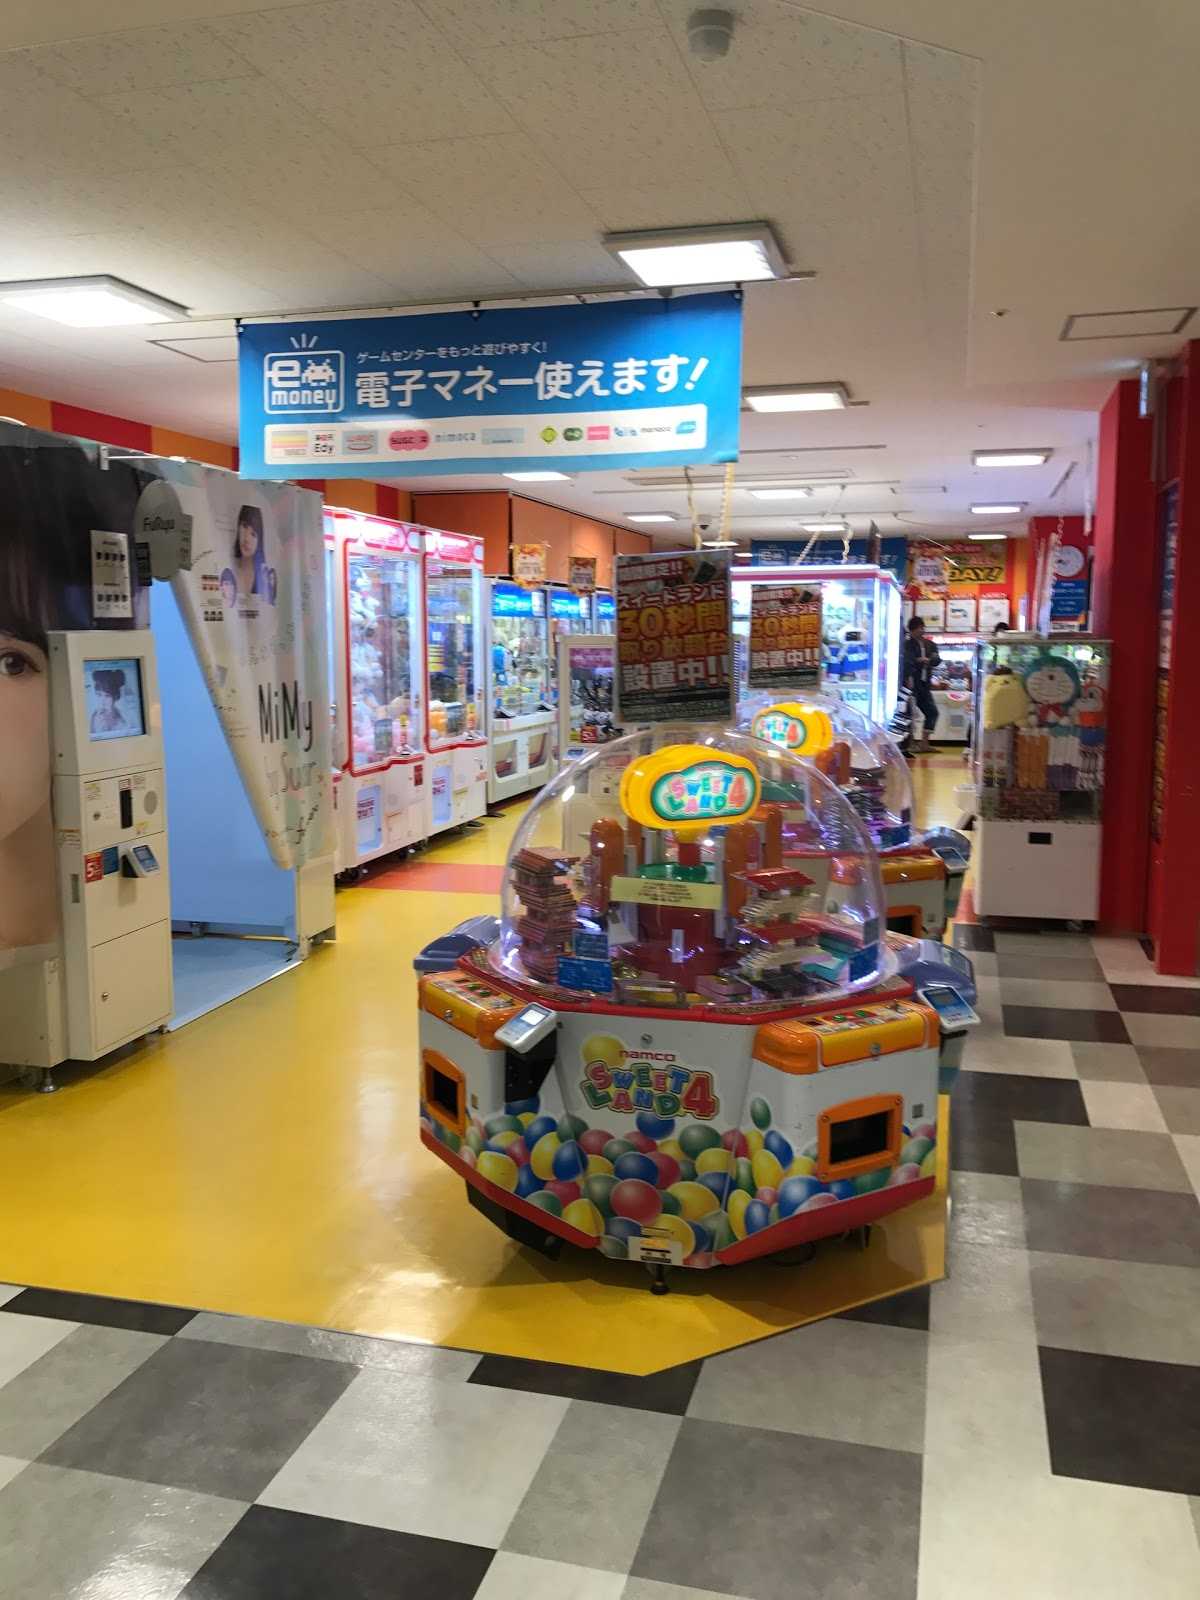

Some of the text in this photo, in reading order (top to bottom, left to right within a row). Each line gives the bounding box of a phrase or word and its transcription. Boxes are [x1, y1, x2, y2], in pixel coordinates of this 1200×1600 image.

[356, 354, 709, 408] 電子マネー使えます!
[272, 389, 336, 411] money
[622, 655, 729, 692] 設置中!!
[259, 680, 312, 752] MiMy
[729, 775, 747, 808] 4
[619, 1050, 676, 1062] namco
[587, 1062, 690, 1094] SWEET
[683, 1071, 719, 1119] 4
[582, 1081, 682, 1117] LAND
